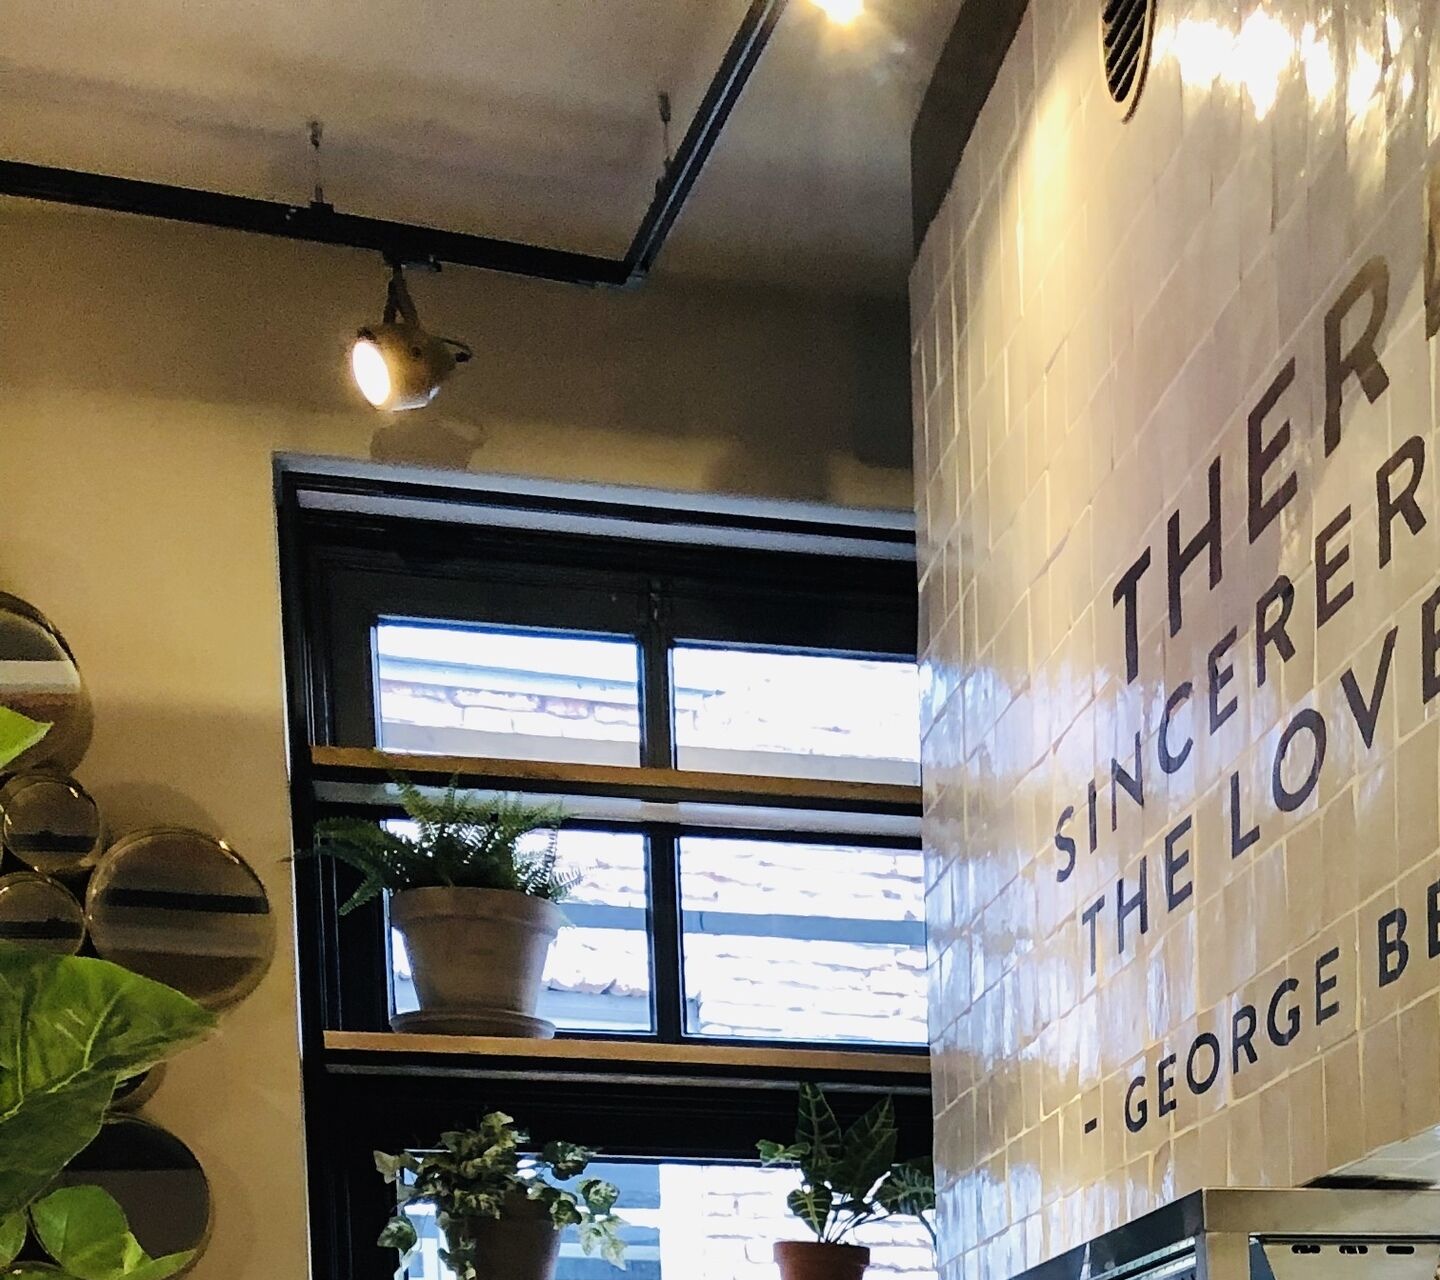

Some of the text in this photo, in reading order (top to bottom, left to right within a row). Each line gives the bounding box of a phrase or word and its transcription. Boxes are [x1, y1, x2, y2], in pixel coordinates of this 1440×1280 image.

[1053, 435, 1427, 884] SINCERER
[1081, 820, 1195, 977] THE
[1123, 947, 1342, 1135] GEORGE
